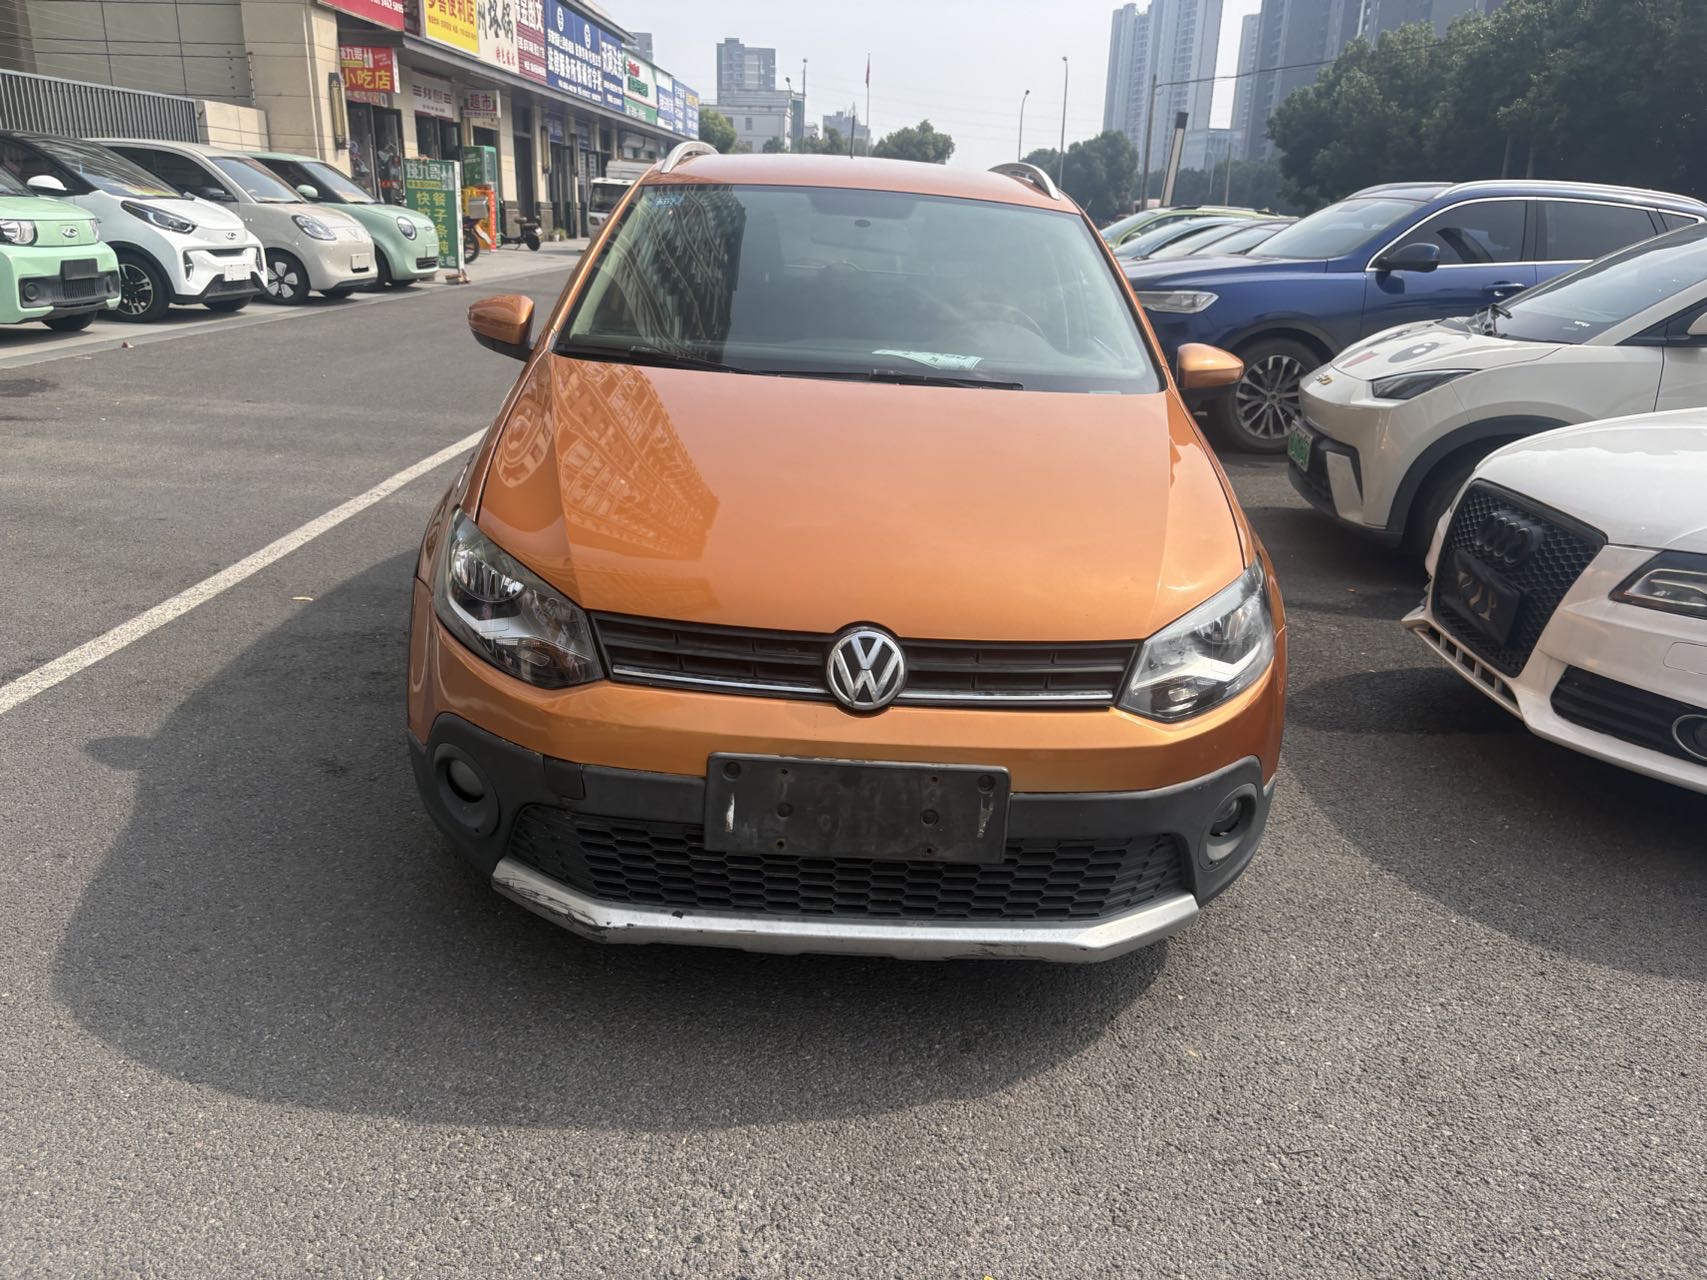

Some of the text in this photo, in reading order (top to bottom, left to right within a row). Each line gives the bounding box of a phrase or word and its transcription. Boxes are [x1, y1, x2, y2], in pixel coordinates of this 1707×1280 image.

[344, 68, 392, 90] 小吃店
[416, 192, 446, 206] 快餐
[828, 630, 905, 709] VW
